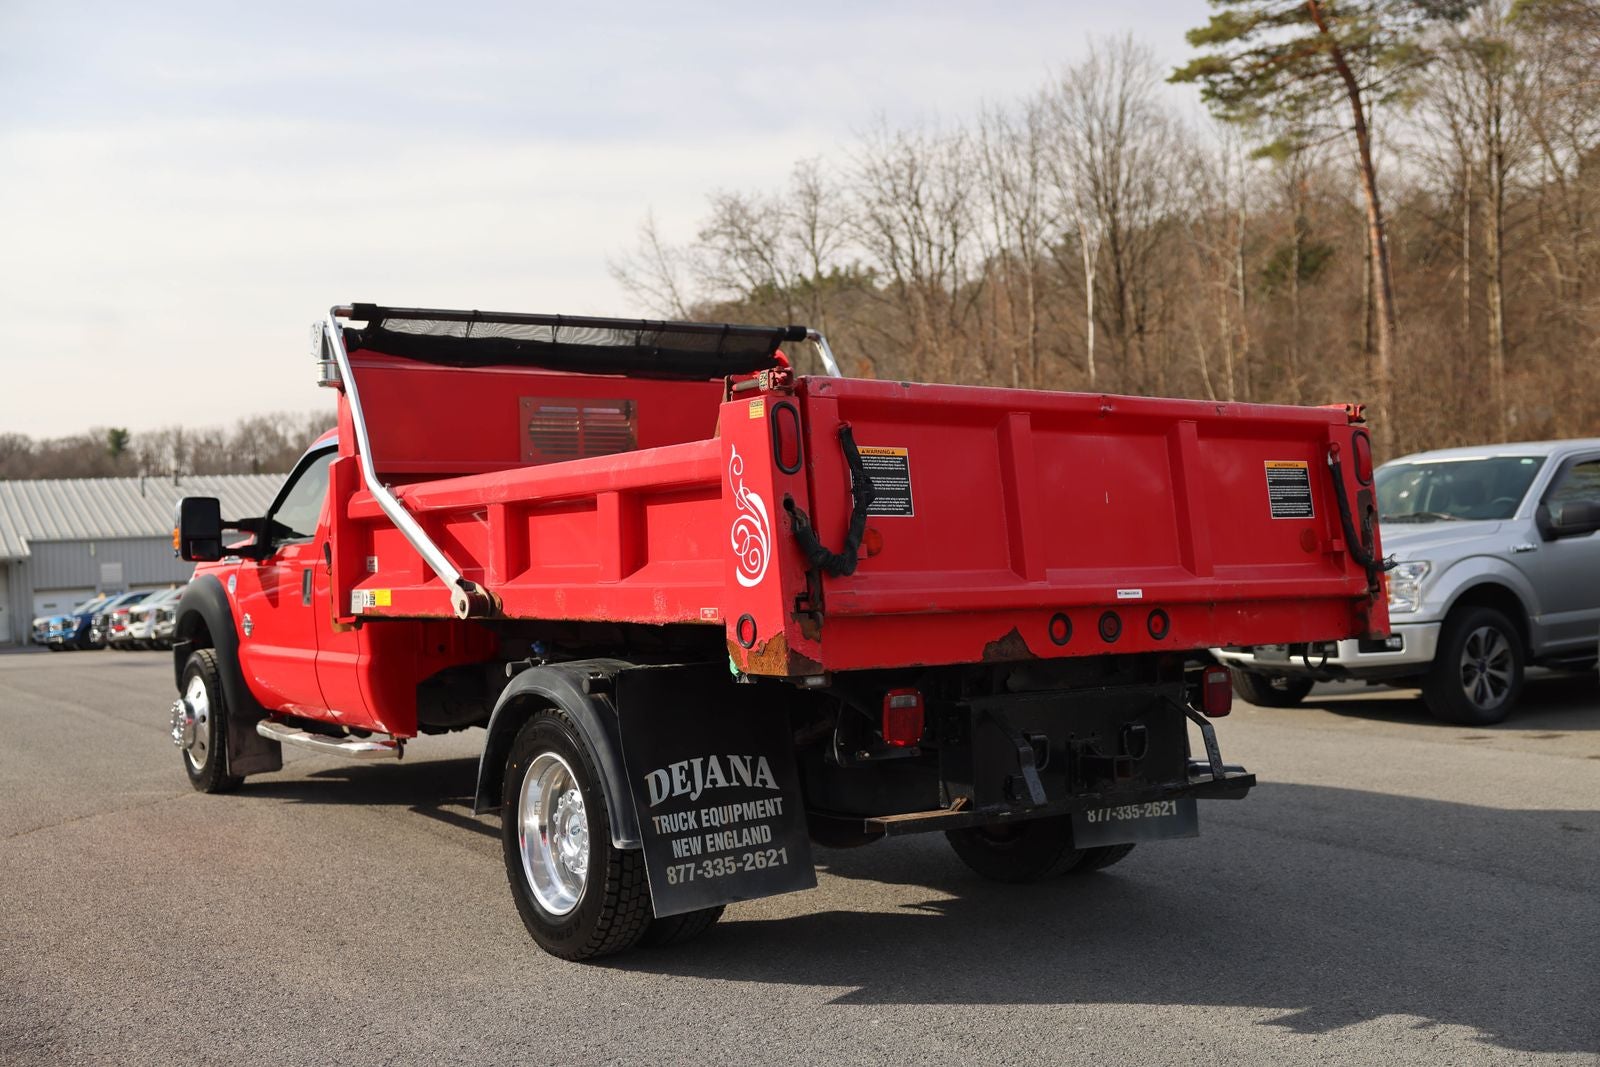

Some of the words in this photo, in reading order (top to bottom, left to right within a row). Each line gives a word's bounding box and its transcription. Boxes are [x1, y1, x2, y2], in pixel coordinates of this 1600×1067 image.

[644, 754, 780, 808] DEJANA
[652, 810, 698, 835] TRUCK
[700, 797, 783, 828] EQUIPMENT
[671, 835, 702, 859] NEW
[705, 824, 772, 853] ENGLAND
[666, 847, 789, 885] 877-335-2621
